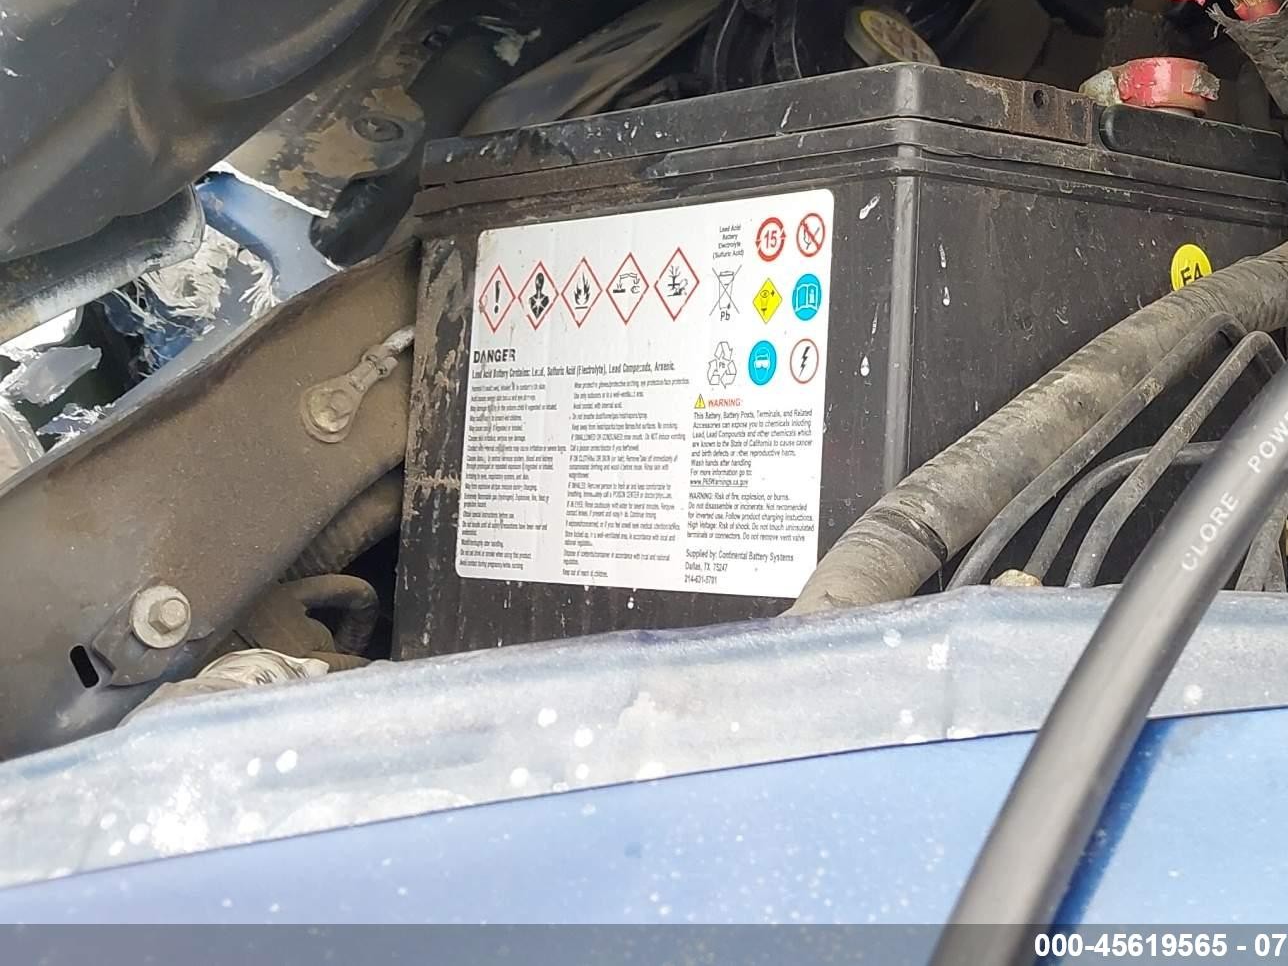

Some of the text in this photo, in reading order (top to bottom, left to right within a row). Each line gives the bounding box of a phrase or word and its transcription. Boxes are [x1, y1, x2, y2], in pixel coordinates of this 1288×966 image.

[764, 230, 777, 249] 15
[720, 311, 731, 322] Pb
[473, 348, 516, 364] DANGER
[1181, 490, 1240, 572] CLORE
